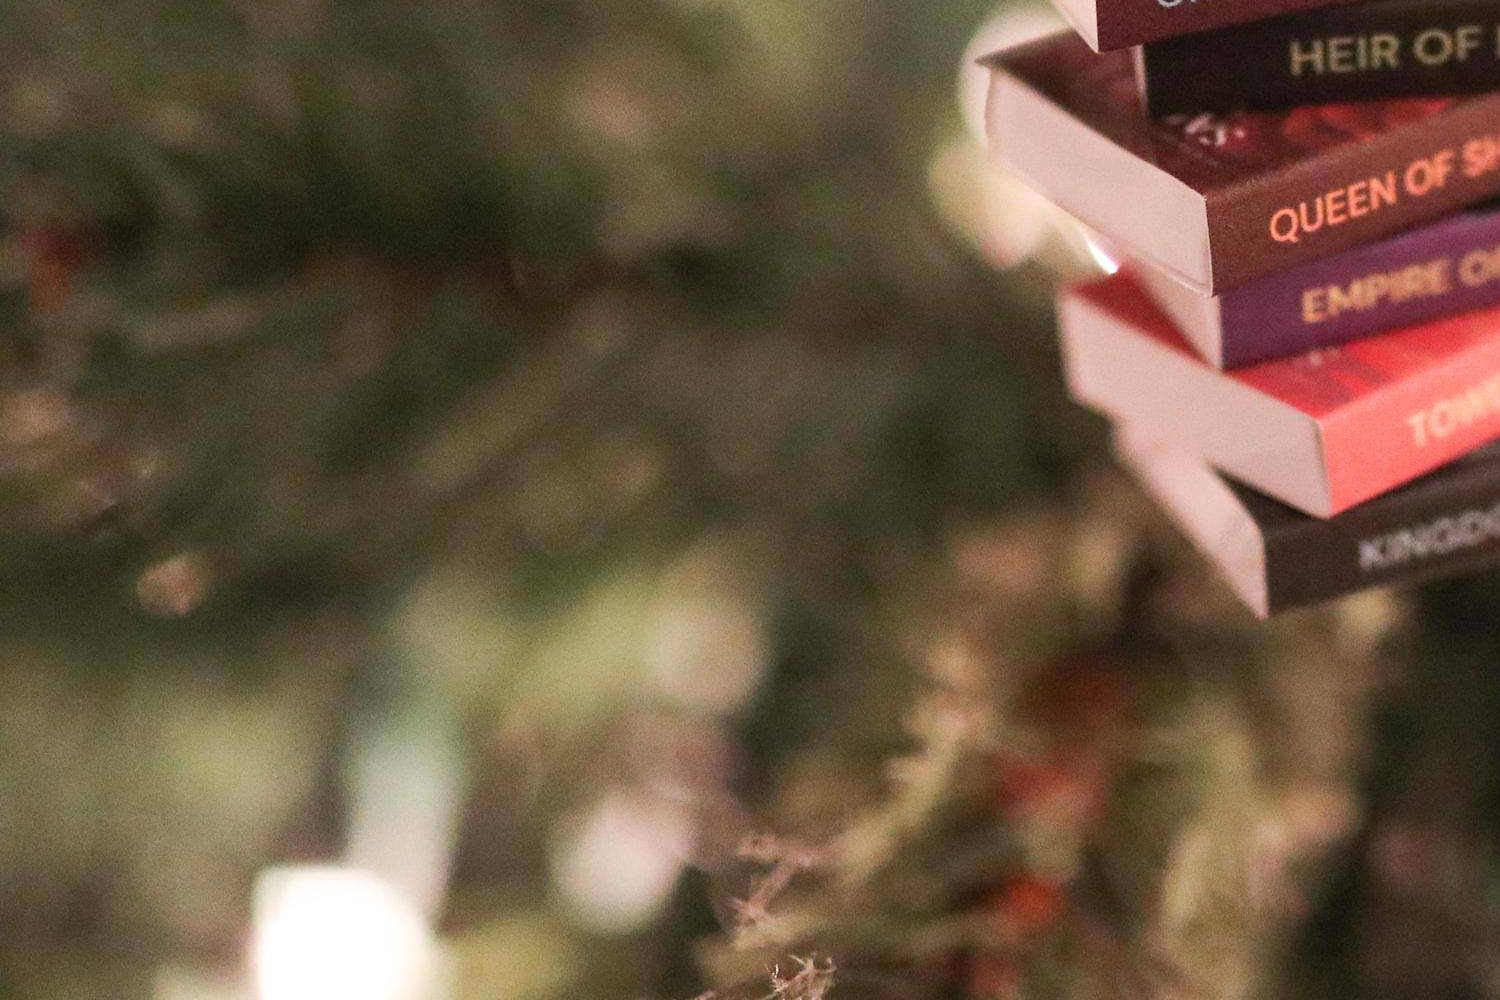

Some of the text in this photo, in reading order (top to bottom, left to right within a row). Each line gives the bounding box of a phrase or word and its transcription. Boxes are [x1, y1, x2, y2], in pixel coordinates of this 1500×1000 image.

[1288, 33, 1399, 77] HEIR
[1413, 25, 1483, 66] OF
[1270, 171, 1398, 243] QUEEN
[1405, 150, 1453, 196] OF
[1301, 259, 1449, 325] EMPIRE
